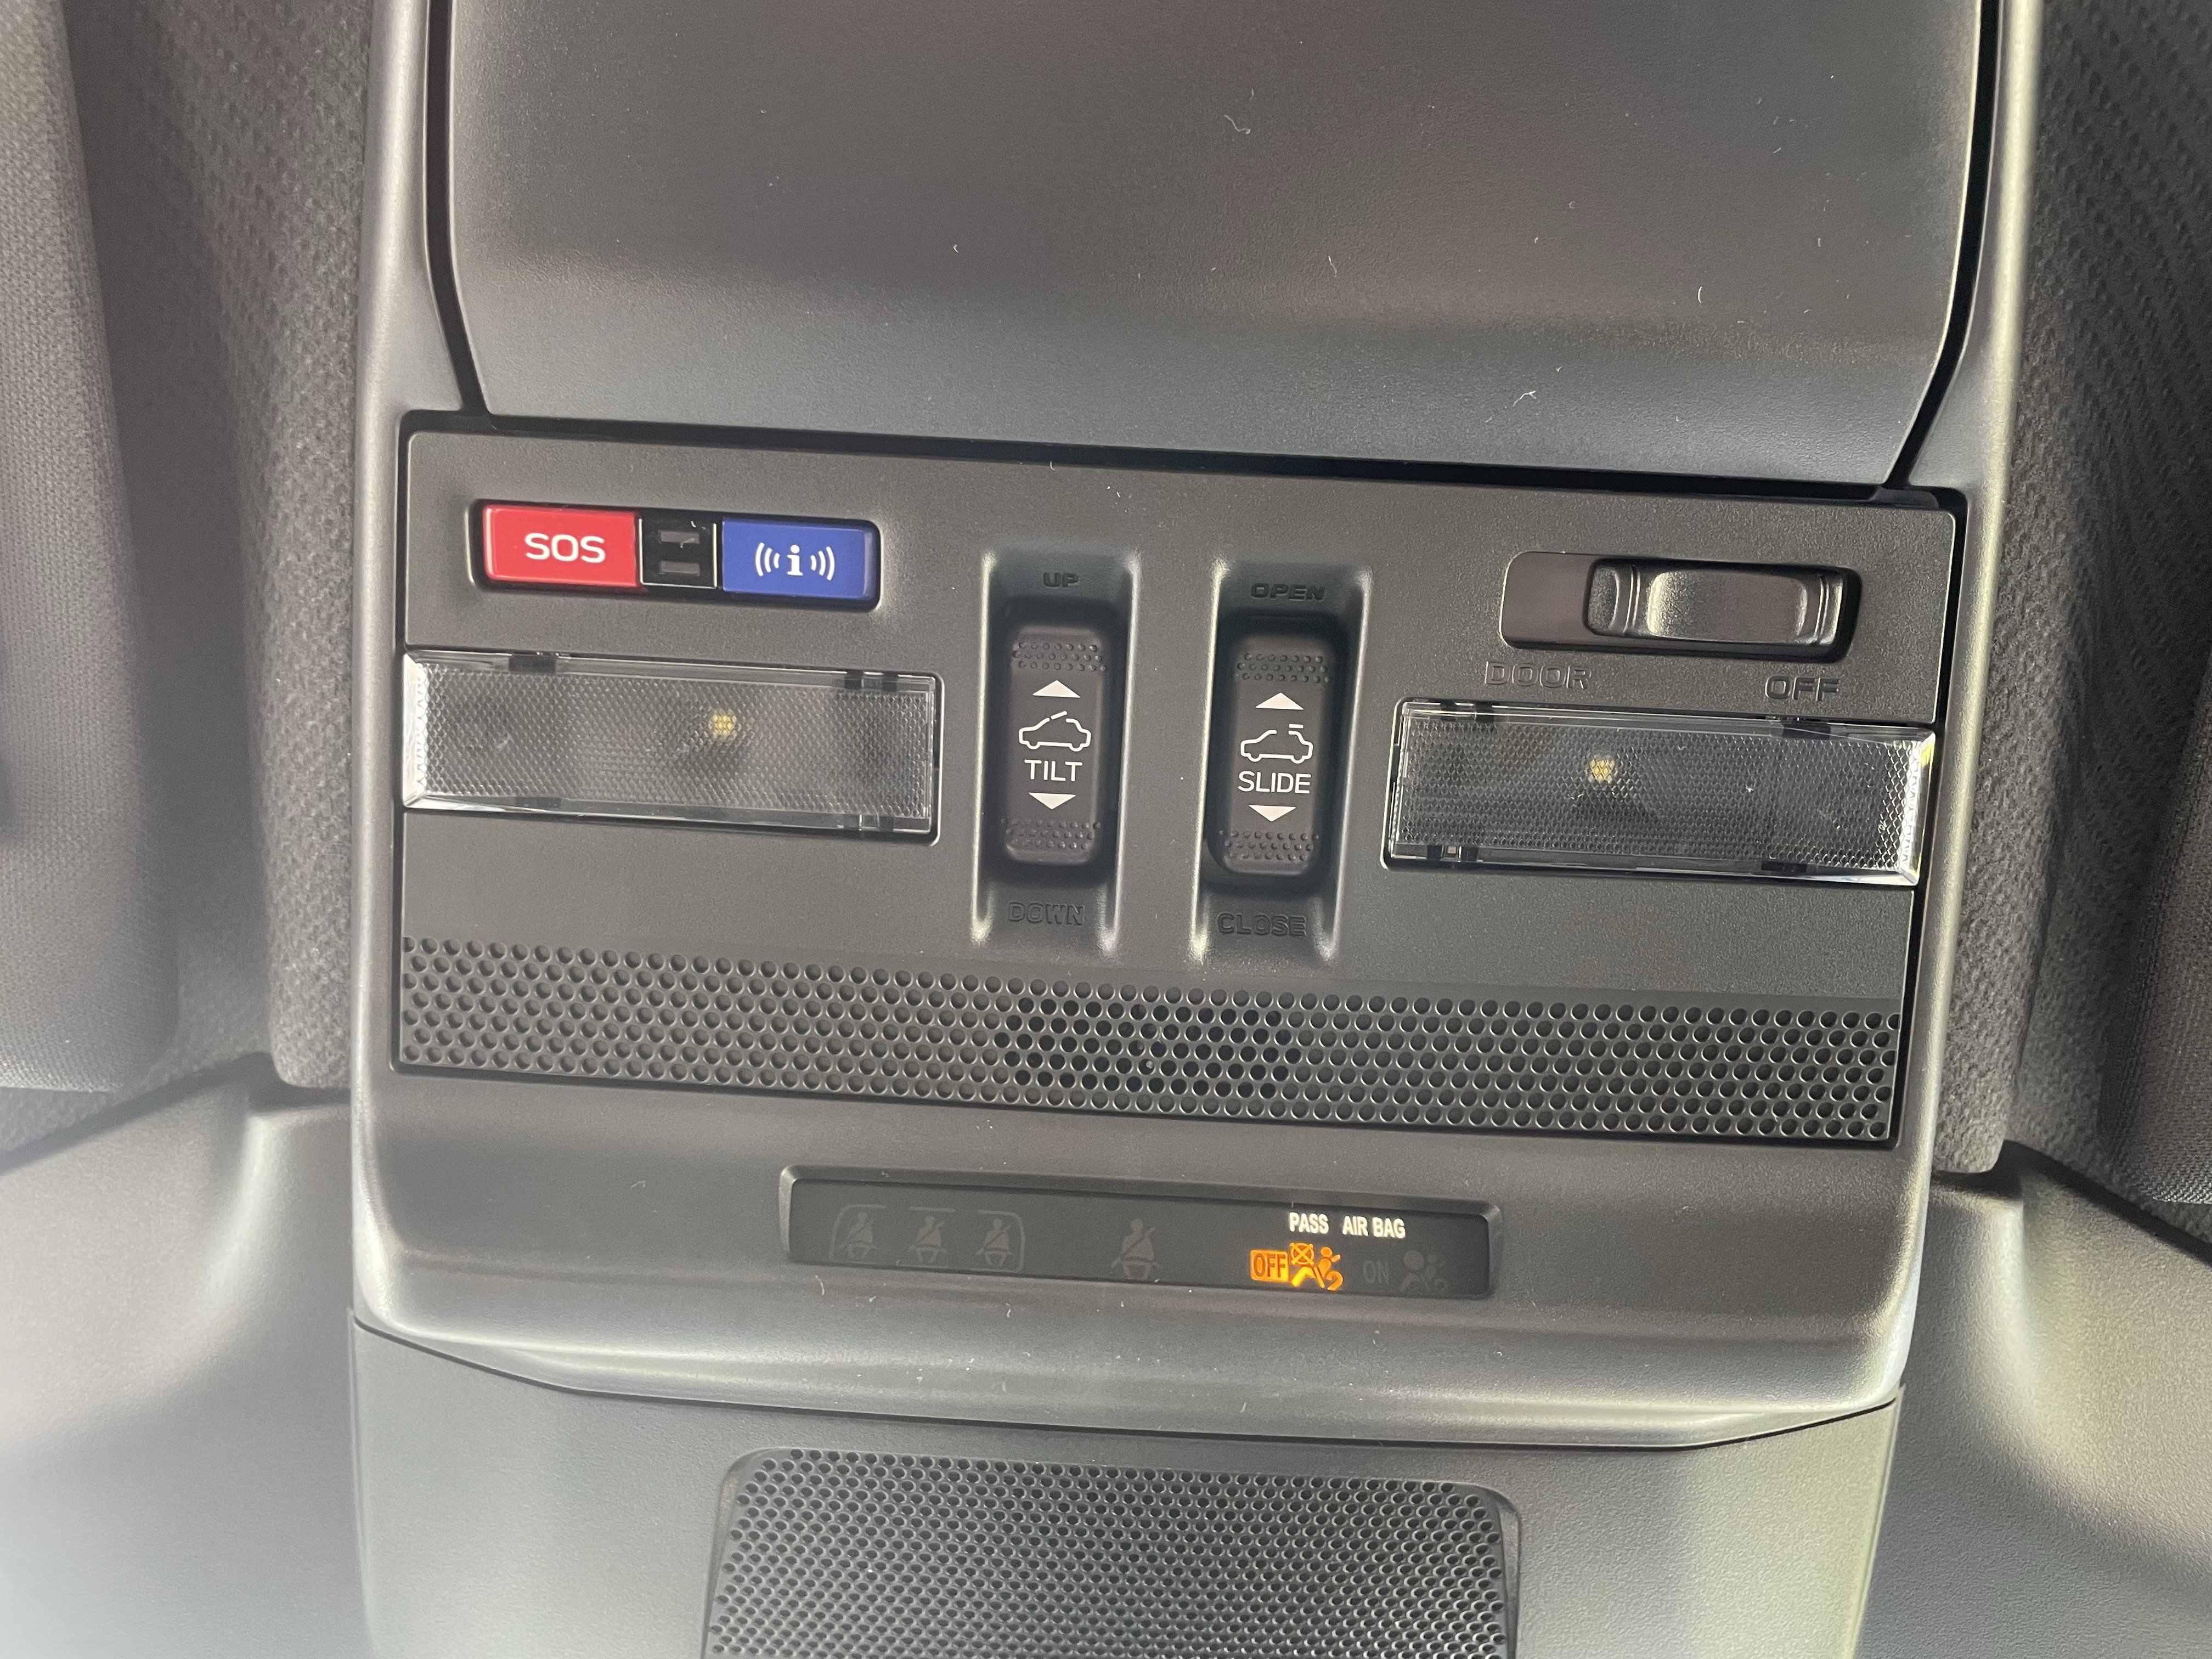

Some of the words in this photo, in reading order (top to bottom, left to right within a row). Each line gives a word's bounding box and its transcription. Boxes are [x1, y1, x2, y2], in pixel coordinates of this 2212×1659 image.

[524, 532, 606, 563] SOS
[1043, 572, 1079, 588] UP
[1250, 583, 1325, 601] OPEN
[1484, 661, 1590, 689] DOOR
[1765, 675, 1839, 701] OFF
[1024, 759, 1082, 782] TILT
[1238, 771, 1311, 794] SLIDE
[1008, 902, 1085, 926] DOWN
[1216, 913, 1307, 936] CLOSE
[1289, 1212, 1329, 1234] PASS
[1342, 1216, 1368, 1236] AIR
[1372, 1217, 1406, 1239] BAG
[1252, 1253, 1286, 1278] OFF
